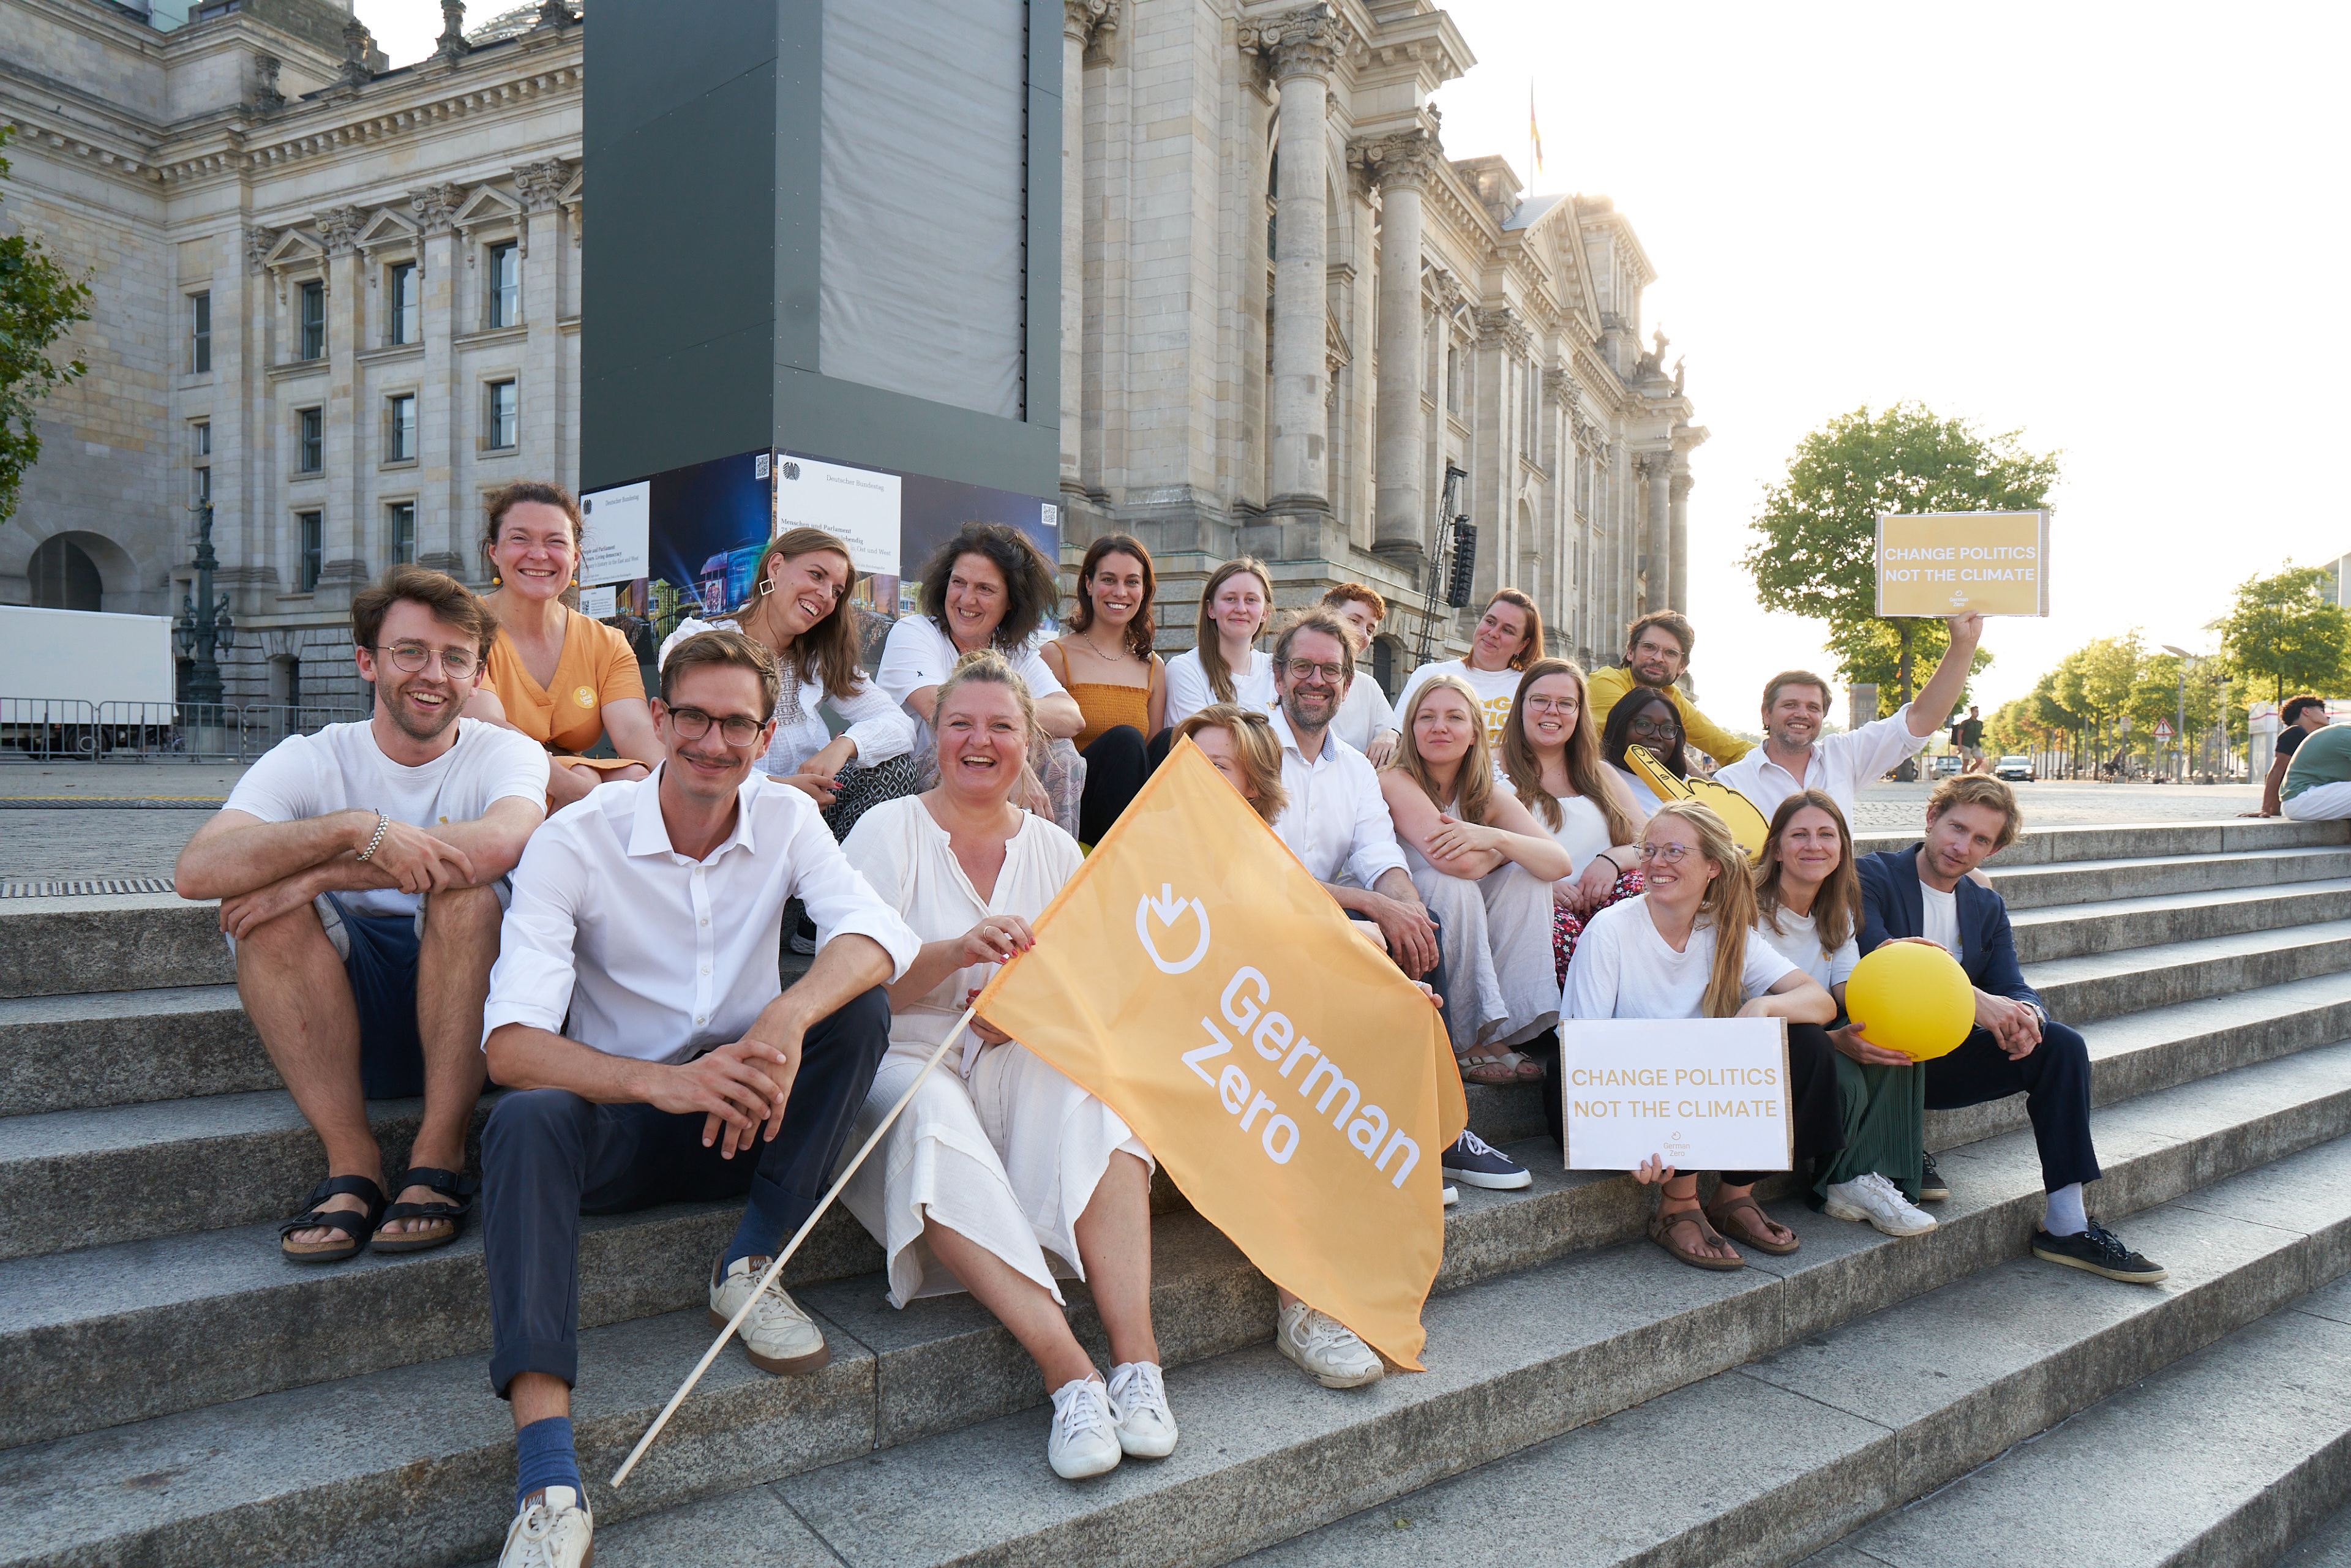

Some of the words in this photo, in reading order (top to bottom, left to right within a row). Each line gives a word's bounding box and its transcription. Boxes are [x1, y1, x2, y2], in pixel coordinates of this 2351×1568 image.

[827, 475, 855, 486] Deutscher
[856, 480, 884, 492] Bundestag
[781, 518, 809, 527] Menschen
[823, 524, 851, 534] Parlament
[841, 535, 863, 544] lebendig
[1884, 547, 1955, 560] CHANGE
[1960, 546, 2036, 560] POLITICS
[1885, 569, 1921, 582] NOT
[1924, 569, 1956, 581] THE
[1960, 568, 2034, 581] CLIMATE
[1220, 966, 1420, 1189] German
[1572, 1069, 1668, 1086] CHANGE
[1675, 1068, 1777, 1086] POLITICS
[1181, 1016, 1300, 1165] Zero
[1575, 1101, 1621, 1117] NOT
[1628, 1101, 1671, 1117] THE
[1678, 1100, 1777, 1117] CLIMATE
